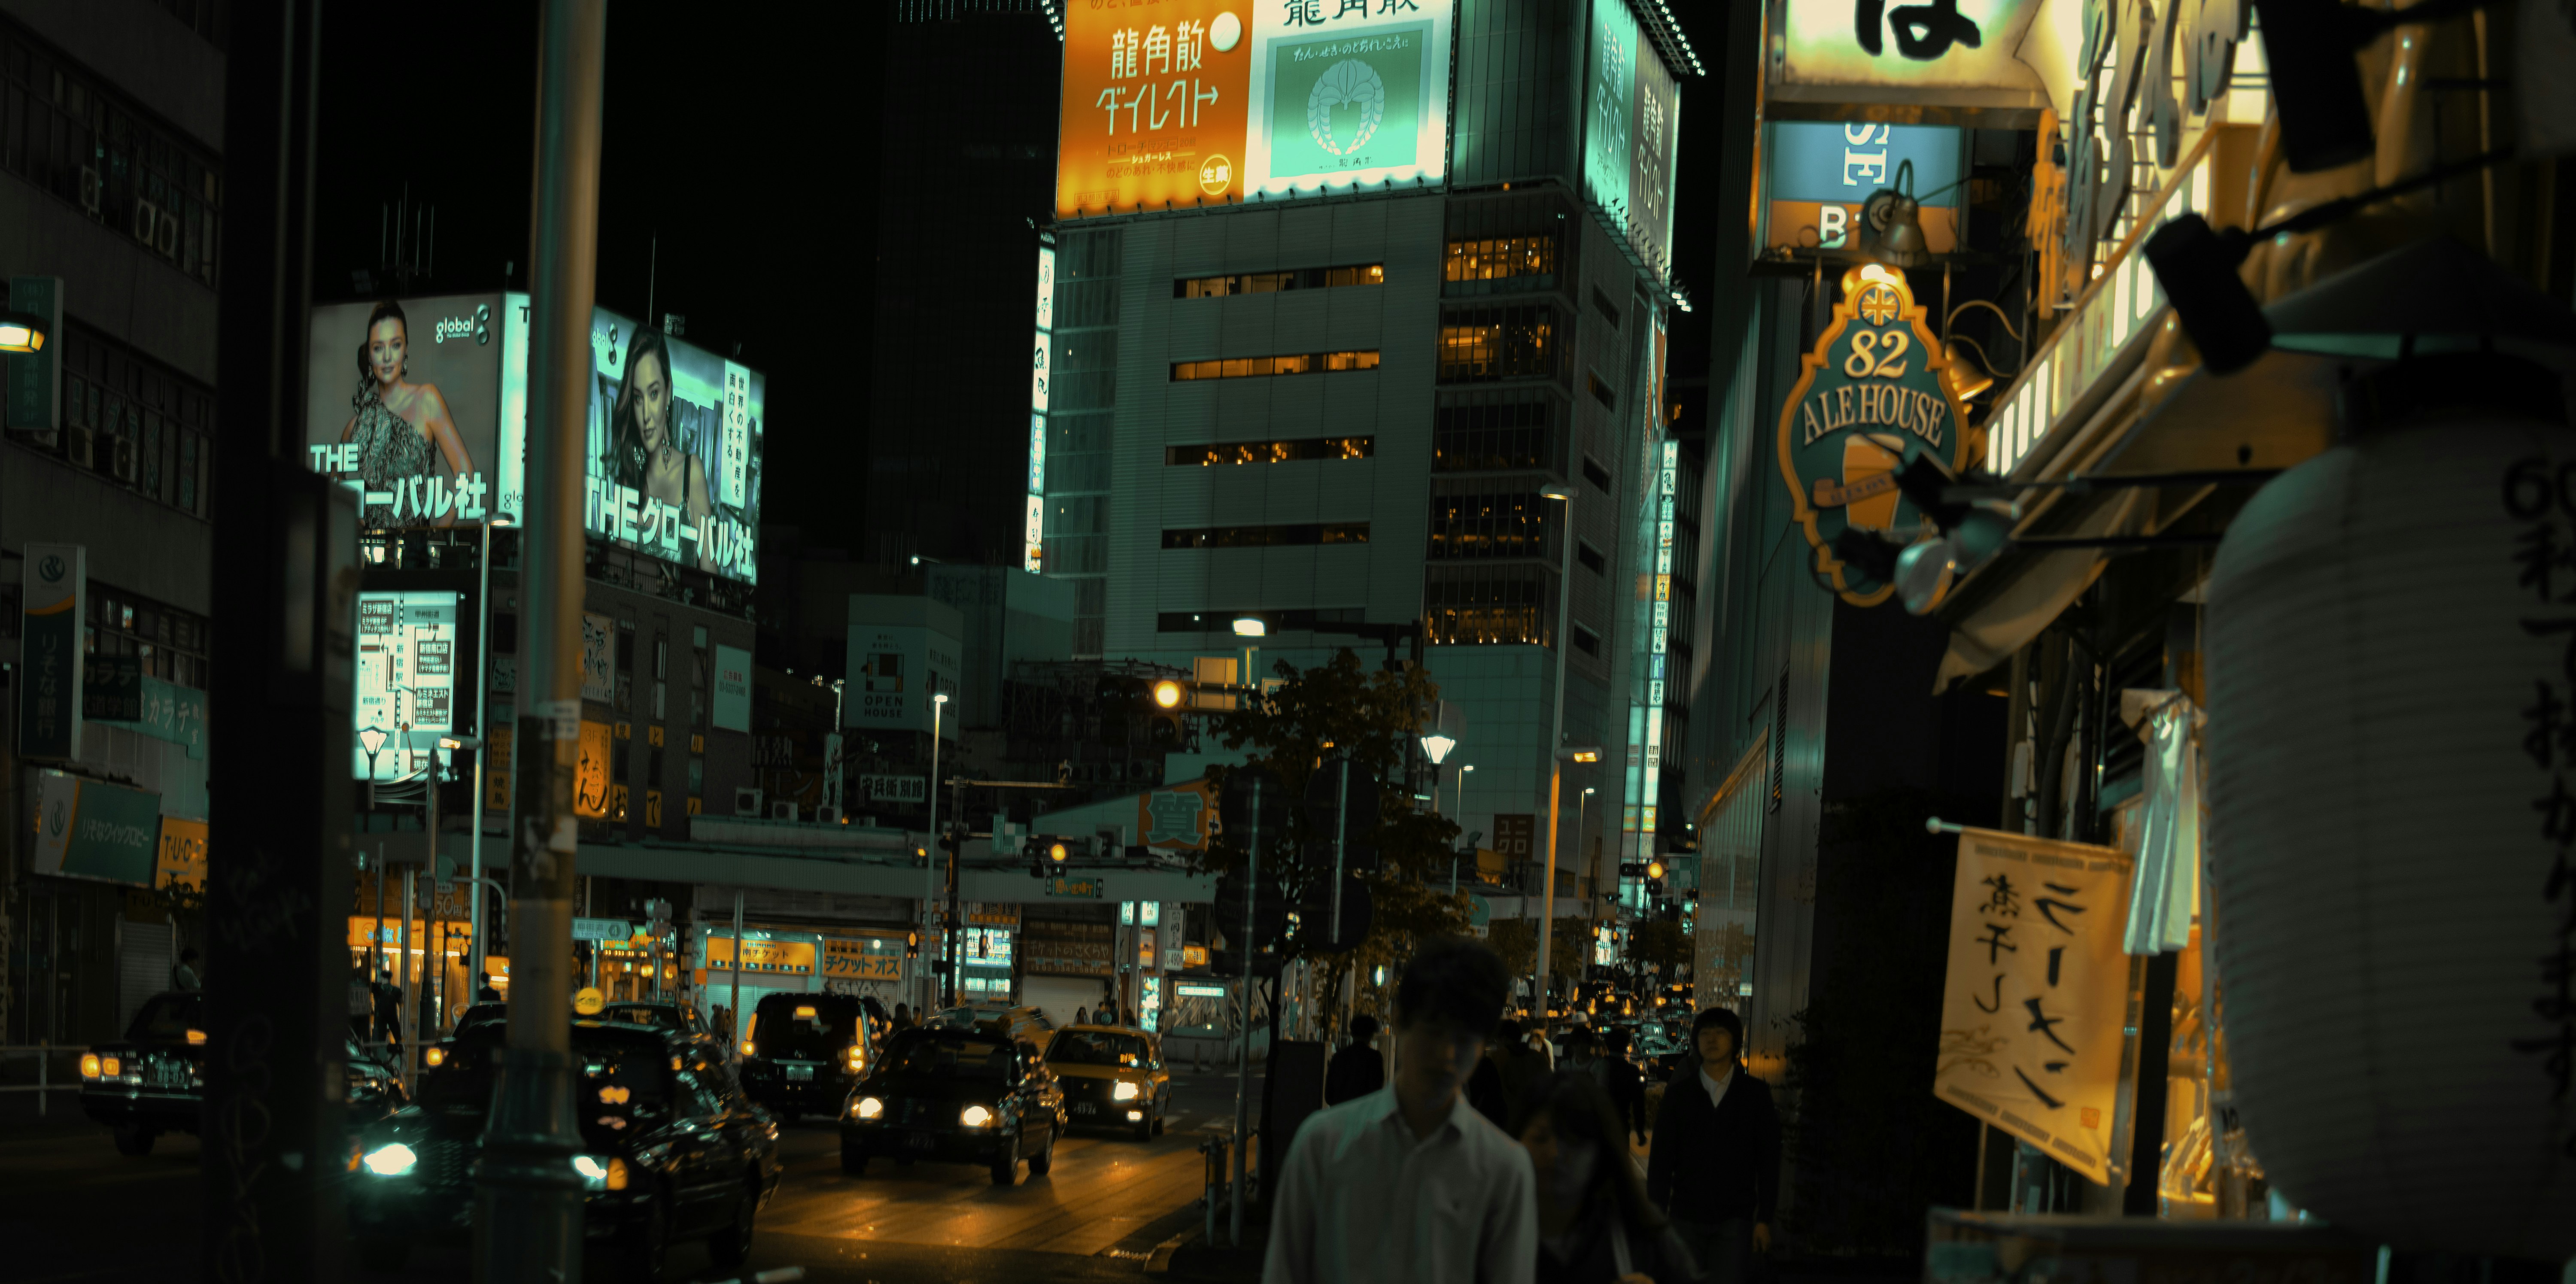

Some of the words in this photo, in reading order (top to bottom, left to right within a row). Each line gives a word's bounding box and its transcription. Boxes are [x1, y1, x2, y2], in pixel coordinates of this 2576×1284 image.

[1112, 18, 1205, 80] 龍角散
[1601, 20, 1625, 104] 龍角散
[1095, 78, 1219, 136] ダイレクト
[1642, 82, 1664, 161] 龍角散
[436, 315, 474, 344] global
[1844, 329, 1910, 379] 82
[726, 373, 736, 467] 面白くする。
[1804, 385, 1856, 446] ALE
[1858, 383, 1946, 449] HOUSE
[734, 376, 745, 498] 世界の不動産を
[310, 443, 359, 473] THE
[362, 602, 392, 614] ミラザ新宿店
[415, 610, 439, 619] 甲州街道
[419, 641, 448, 654] 新宿南口店
[37, 632, 58, 740] りそな銀行
[362, 696, 386, 705] 新宿通り
[865, 695, 903, 707] OPEN
[940, 677, 957, 699] OPEN
[416, 698, 433, 709] 新宿店
[864, 709, 902, 718] HOUSE
